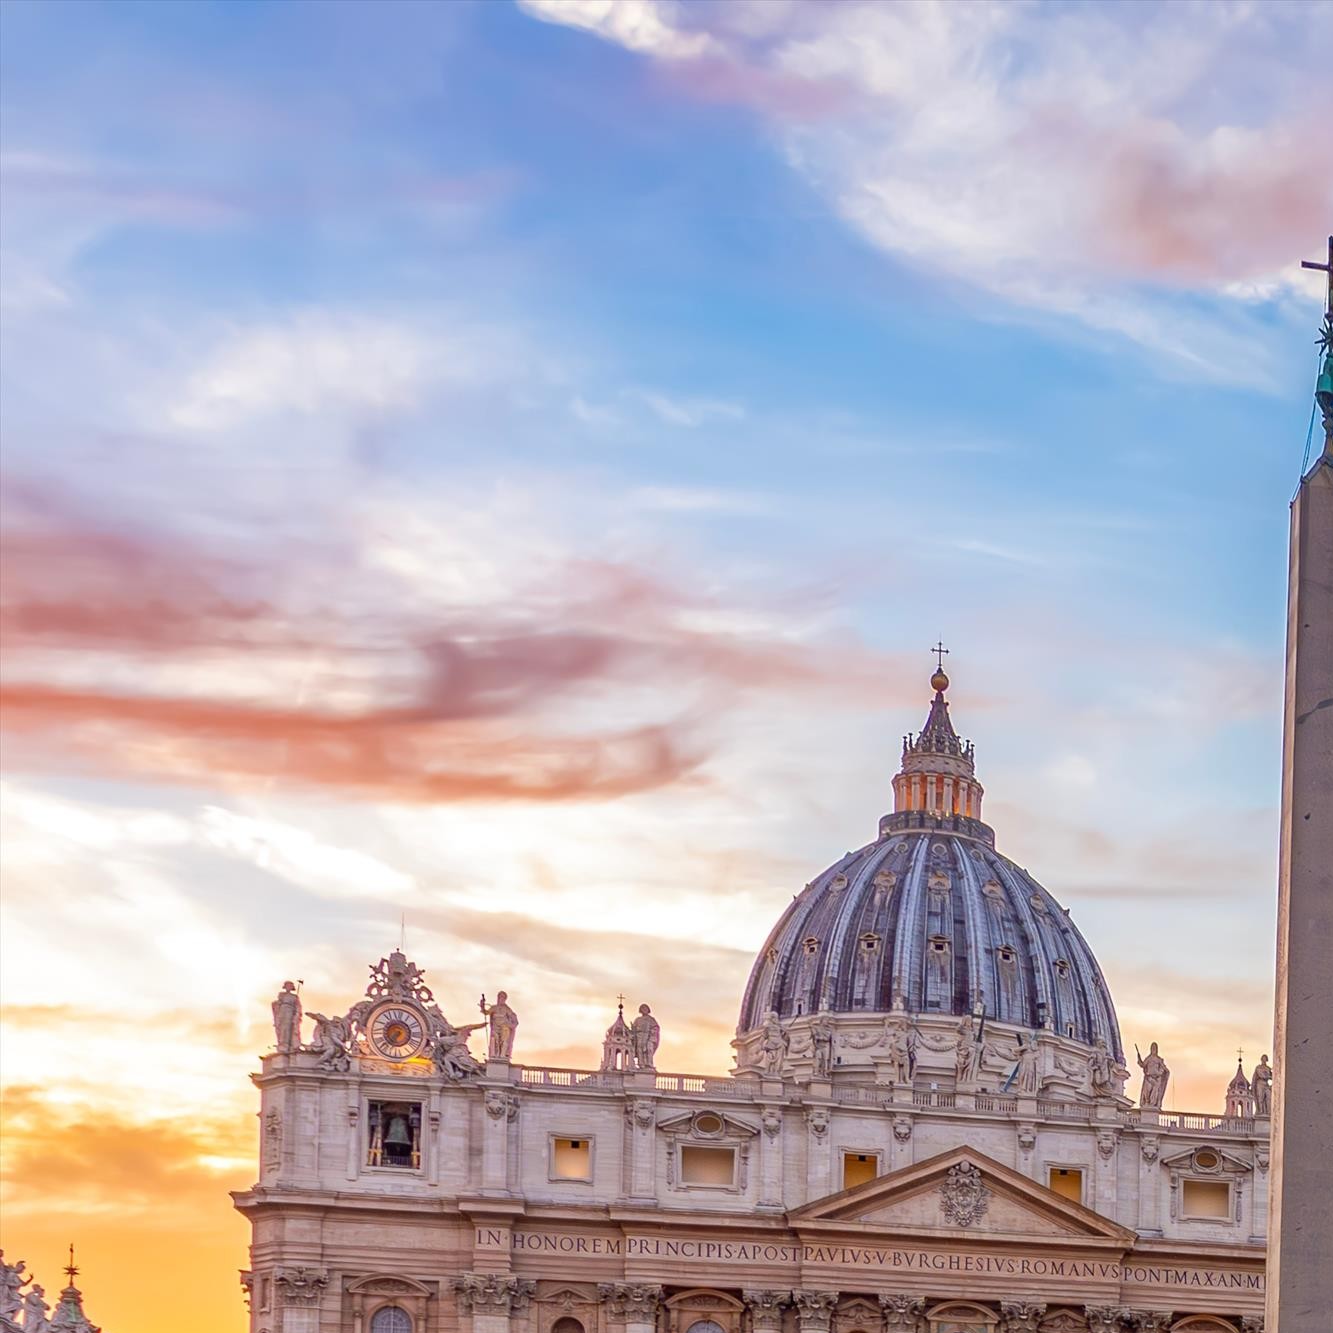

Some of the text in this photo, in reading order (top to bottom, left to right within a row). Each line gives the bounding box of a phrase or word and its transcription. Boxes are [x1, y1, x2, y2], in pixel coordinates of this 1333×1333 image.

[477, 1230, 500, 1245] IN
[513, 1233, 621, 1255] HONOREM
[627, 1239, 733, 1259] PRINCIPIS
[737, 1244, 799, 1262] APOST
[804, 1246, 871, 1264] PAVLVS
[876, 1250, 889, 1265] V
[892, 1252, 1016, 1273] BVRGHESIVS
[1021, 1259, 1119, 1279] ROMANVS
[1124, 1267, 1172, 1284] PONT
[1174, 1270, 1214, 1287] MAX
[1217, 1273, 1243, 1288] AN
[1247, 1275, 1265, 1290] M
